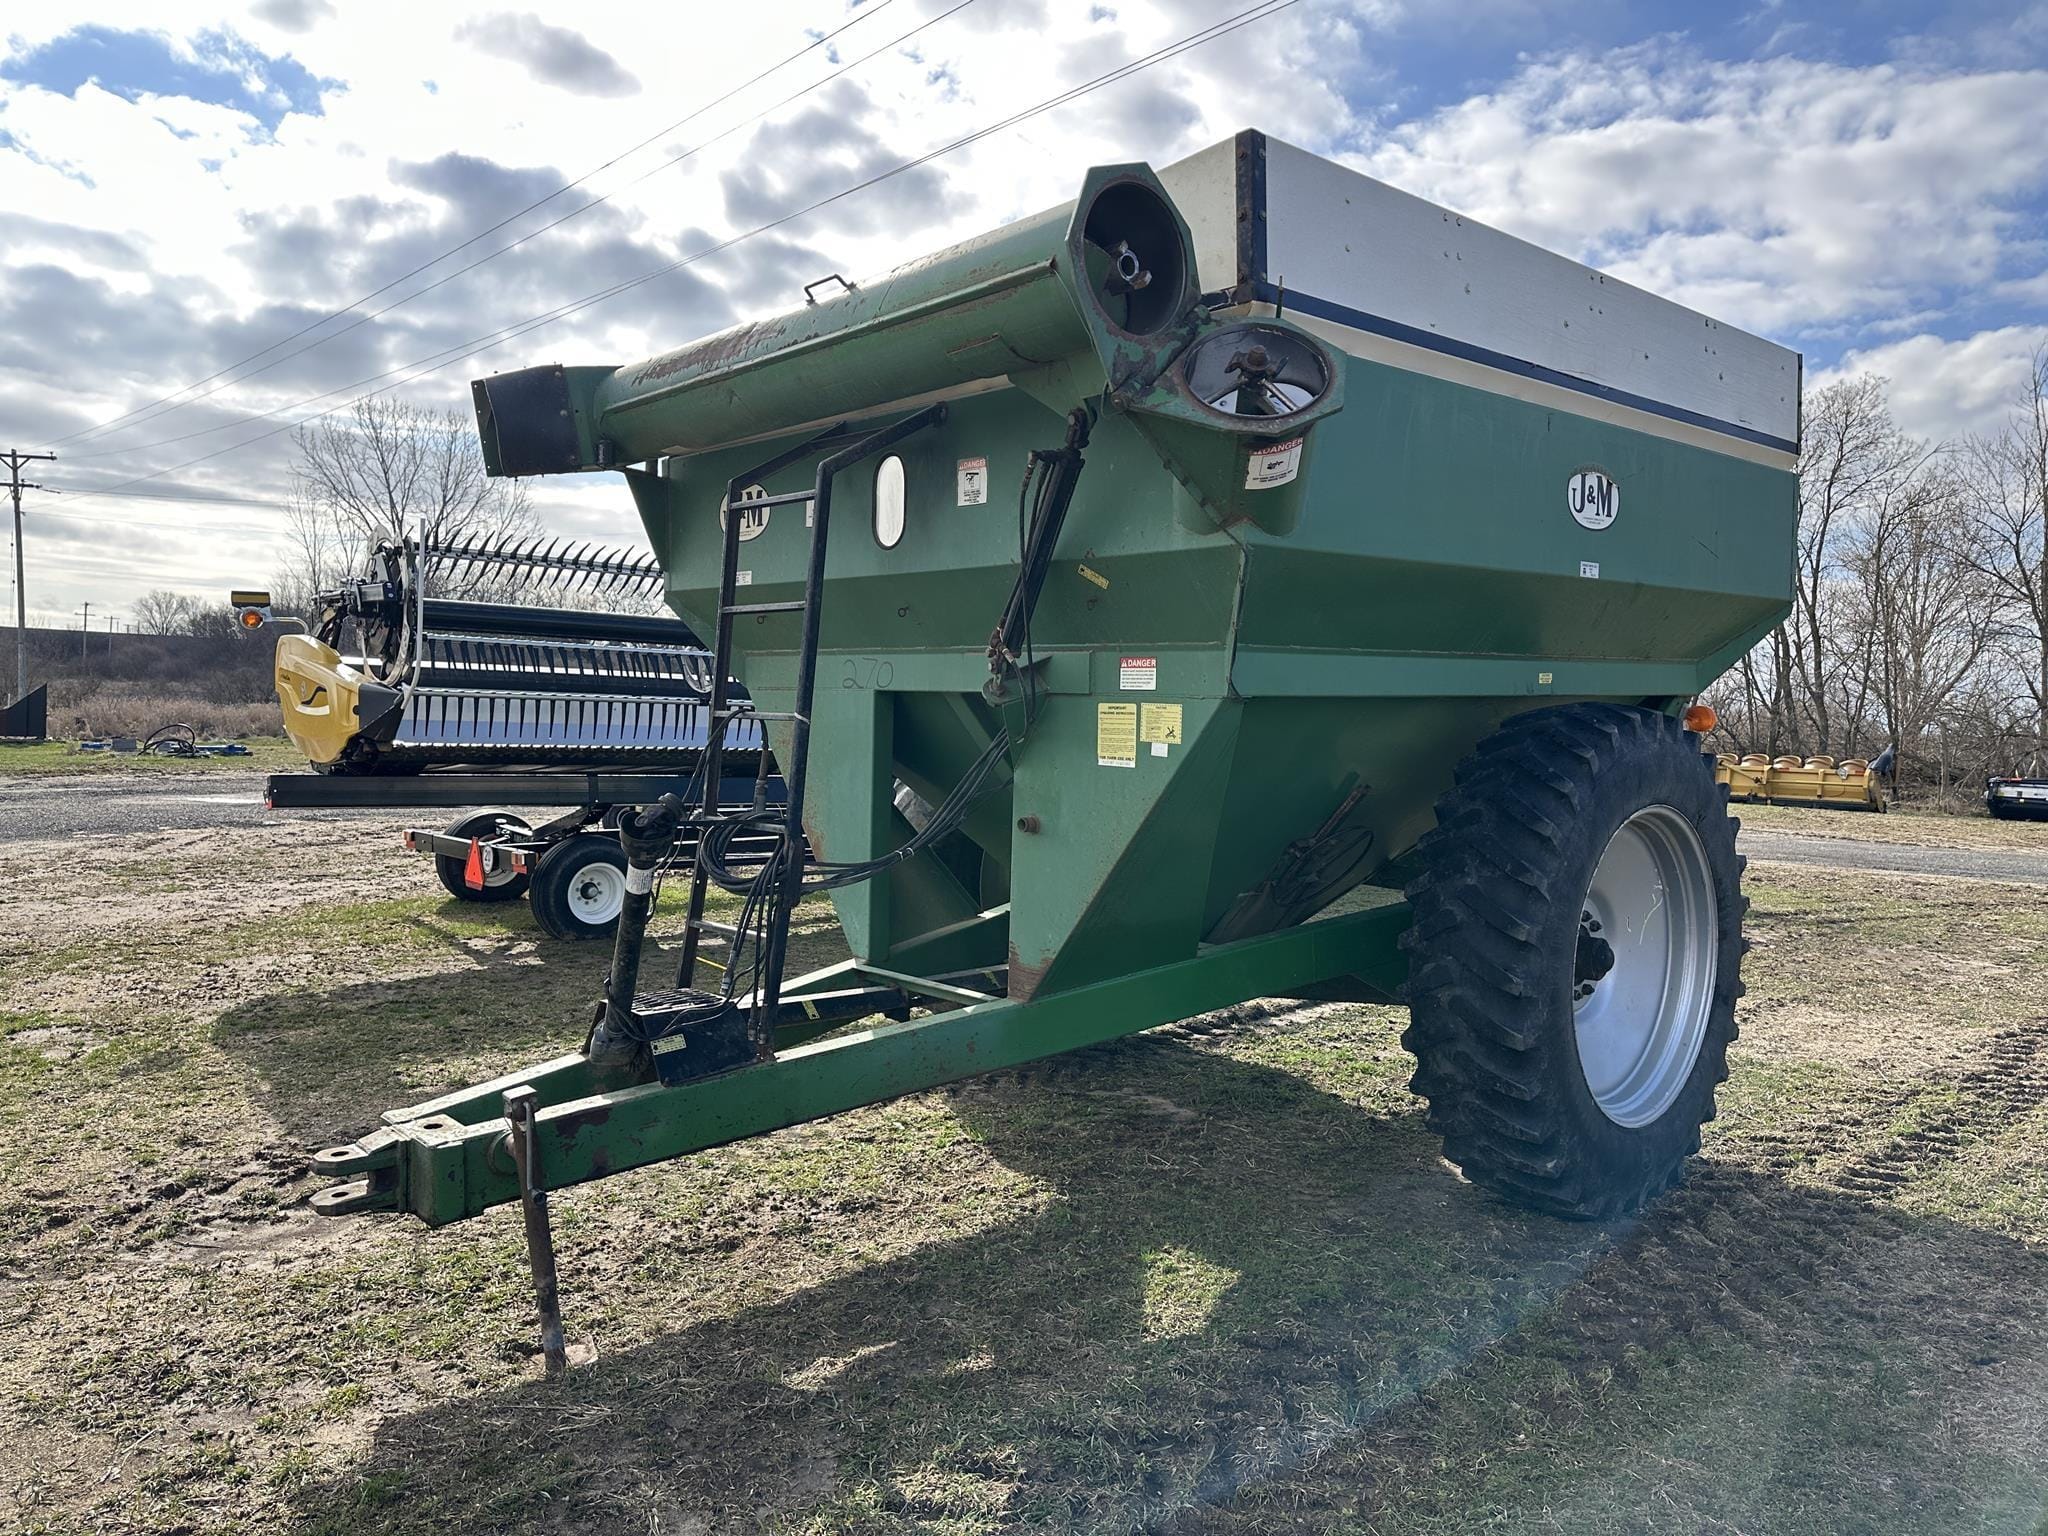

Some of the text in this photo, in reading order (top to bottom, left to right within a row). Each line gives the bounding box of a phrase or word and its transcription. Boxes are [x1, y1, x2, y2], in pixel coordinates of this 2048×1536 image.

[1263, 437, 1303, 455] DANGER
[1572, 473, 1612, 518] J&M
[842, 657, 894, 689] 270
[1127, 659, 1156, 668] DANGER
